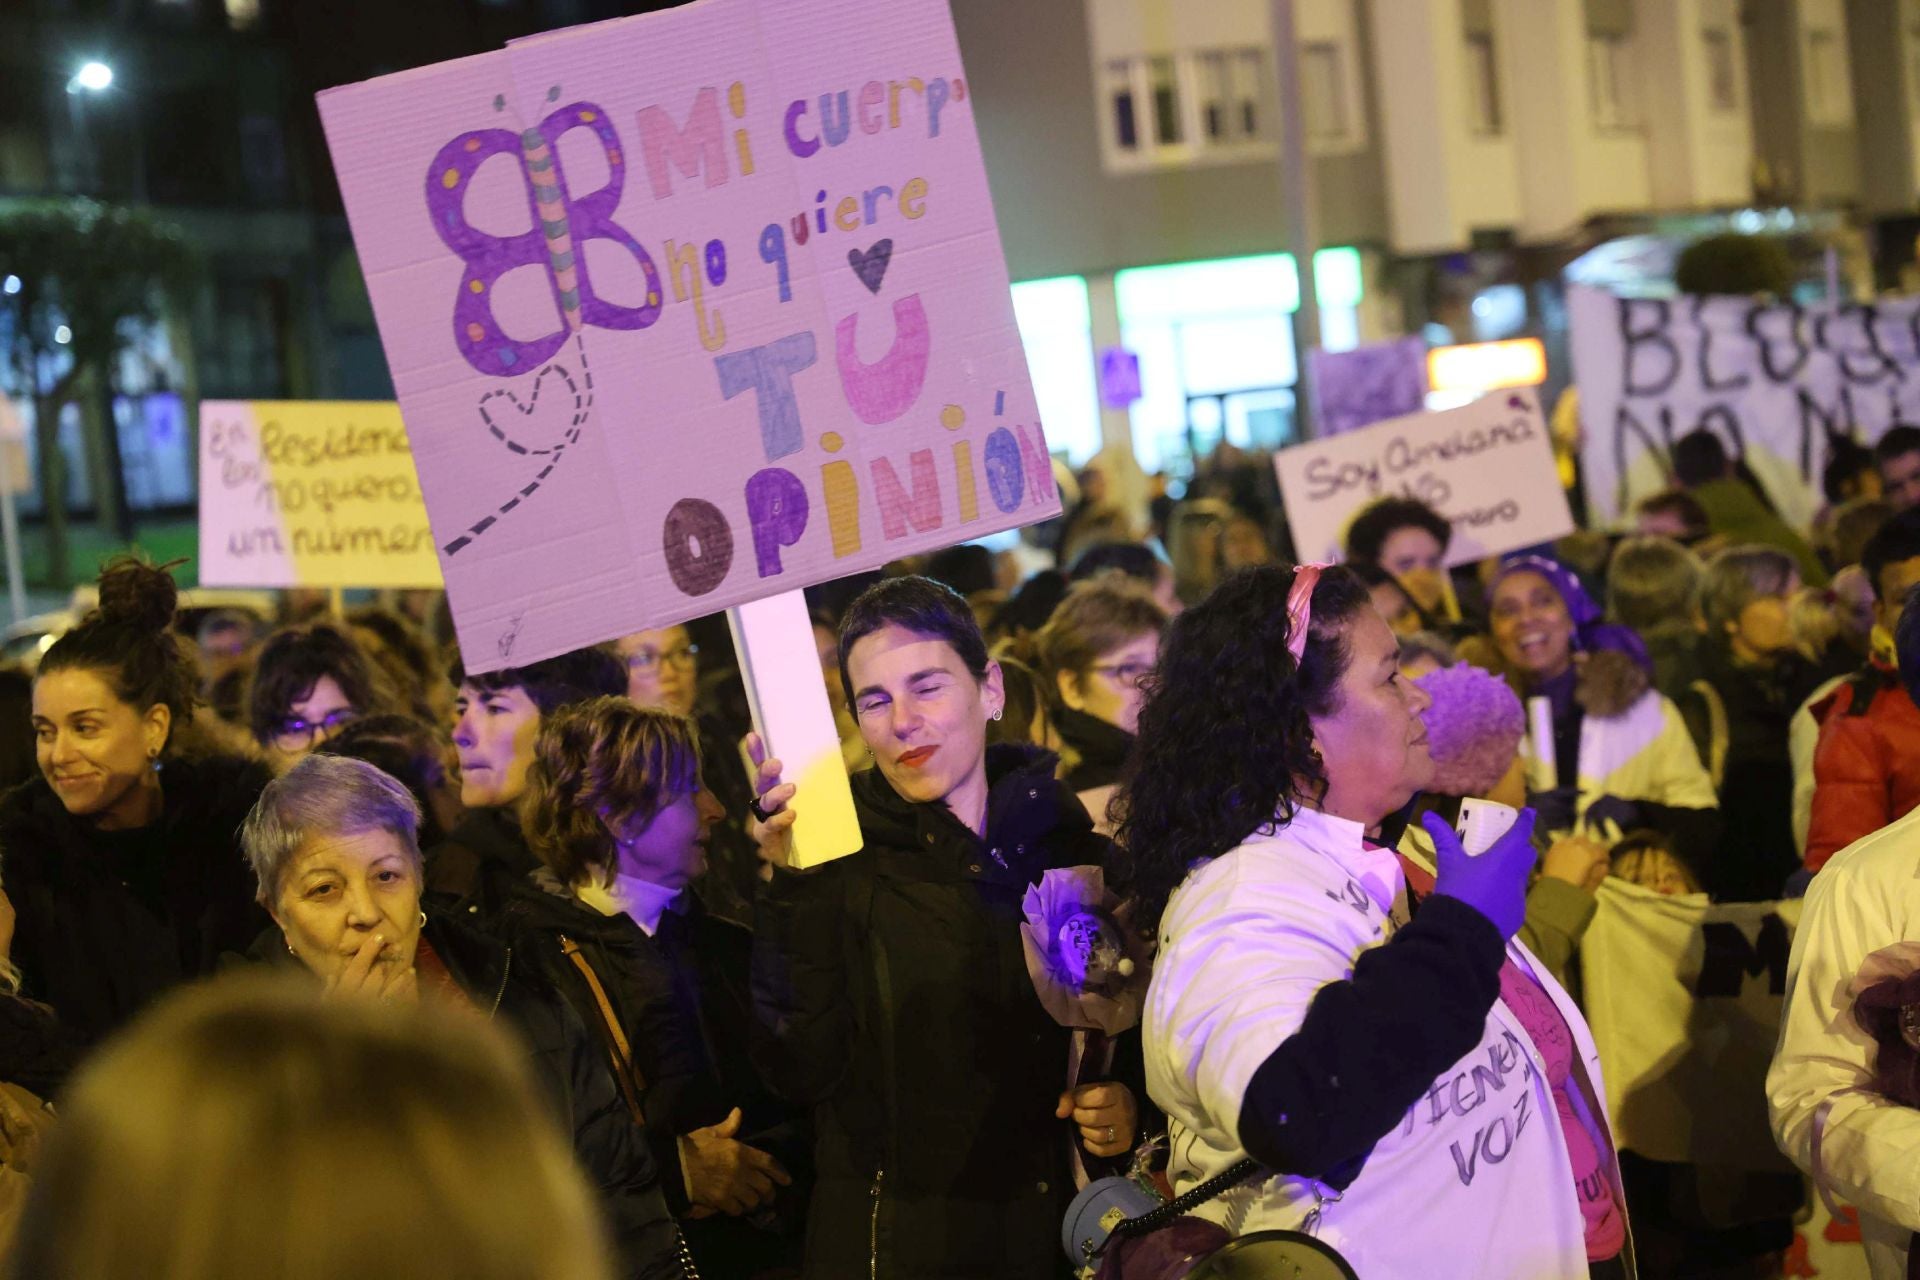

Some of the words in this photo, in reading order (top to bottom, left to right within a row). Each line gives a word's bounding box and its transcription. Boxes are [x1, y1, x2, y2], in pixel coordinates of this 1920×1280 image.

[636, 80, 755, 200] Mi
[758, 176, 930, 303] quiere
[713, 292, 932, 464] TU
[1303, 456, 1383, 502] Soy
